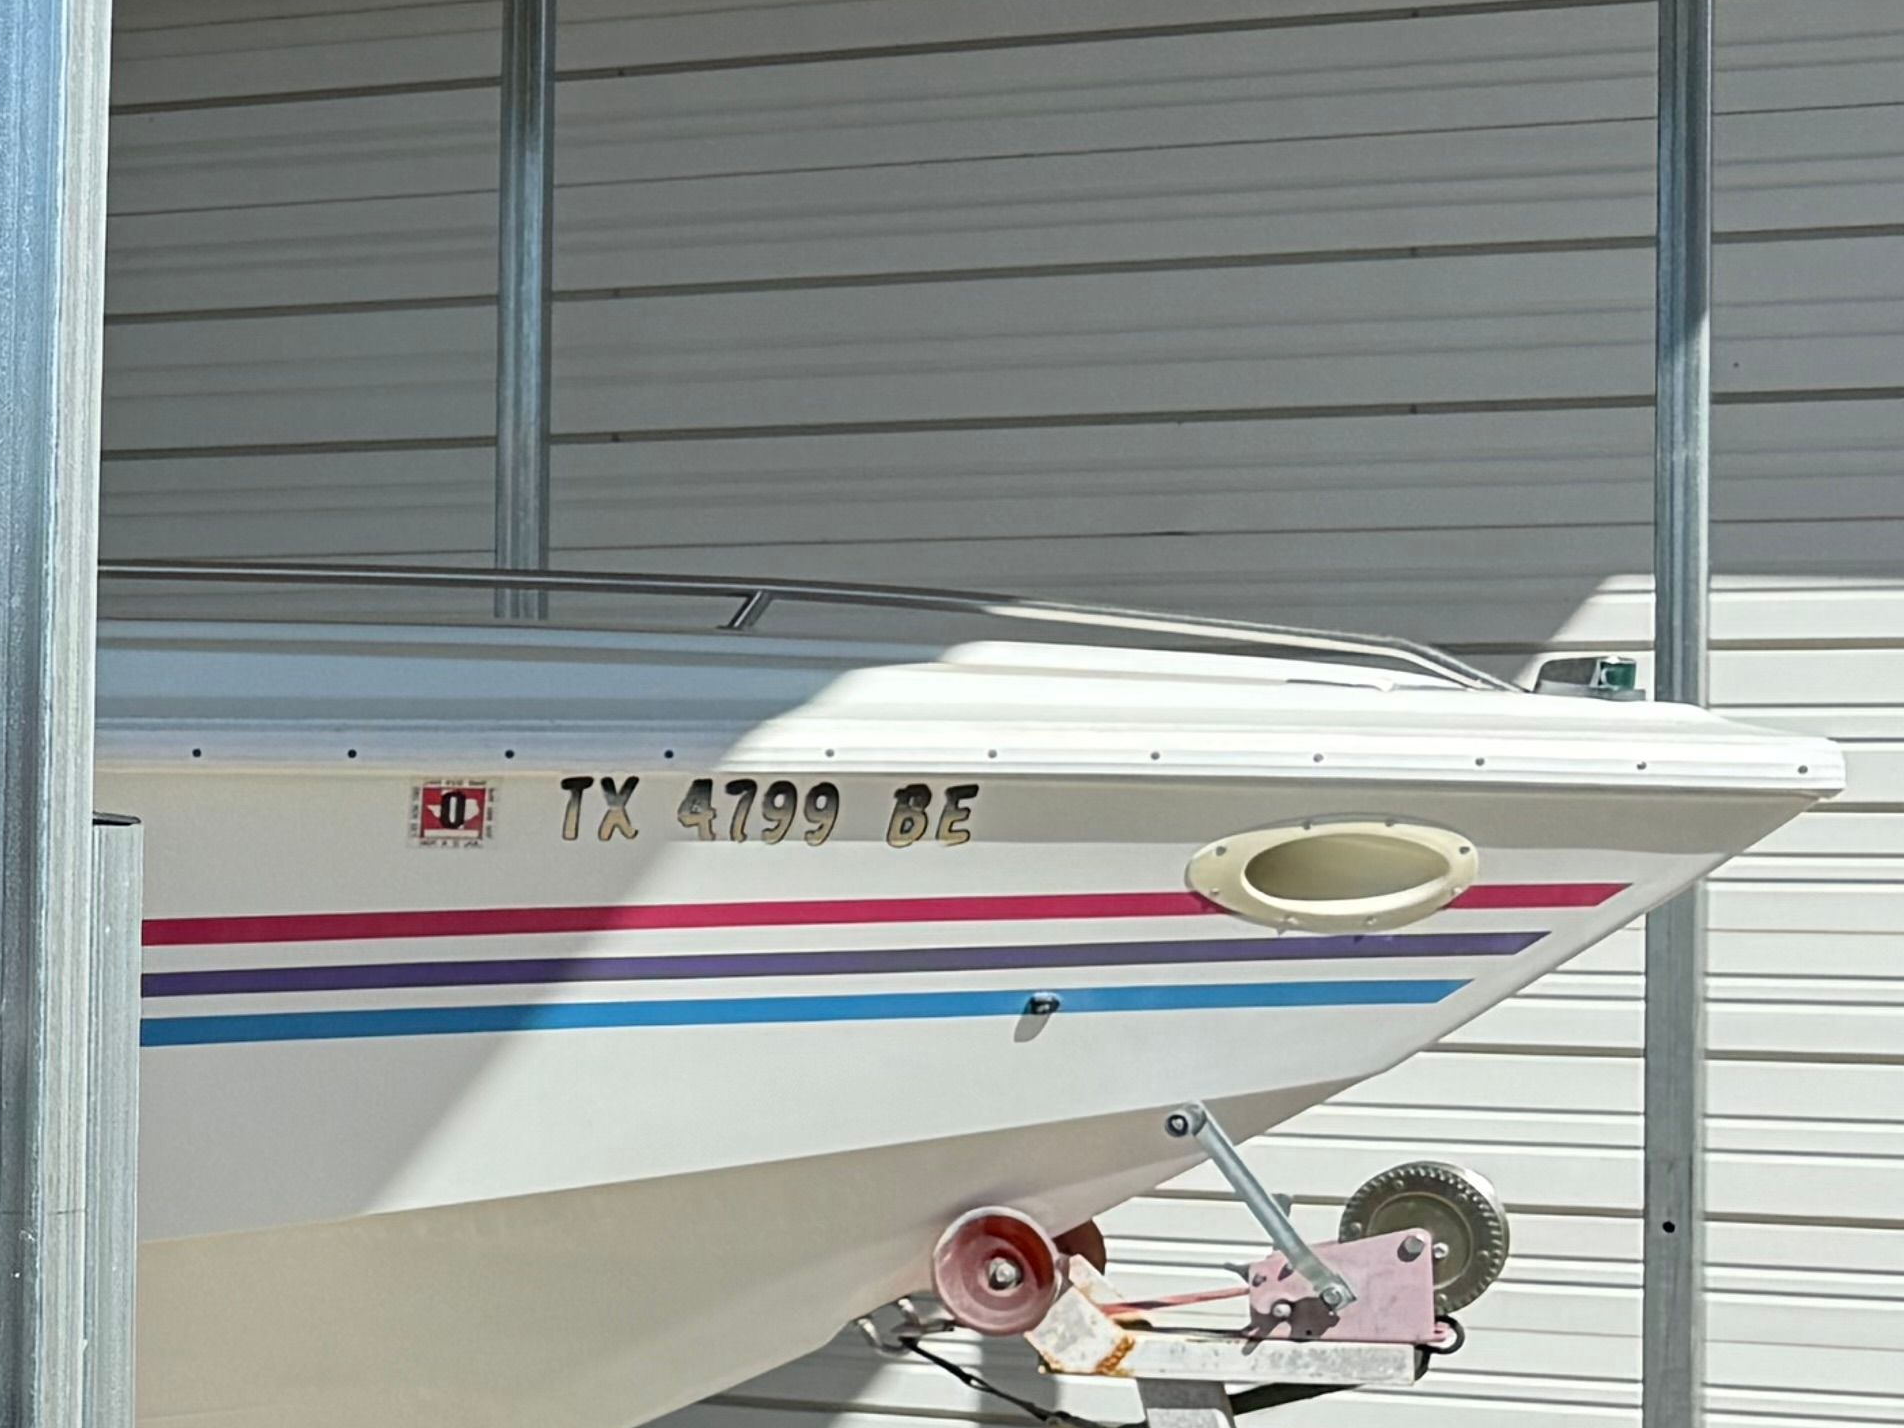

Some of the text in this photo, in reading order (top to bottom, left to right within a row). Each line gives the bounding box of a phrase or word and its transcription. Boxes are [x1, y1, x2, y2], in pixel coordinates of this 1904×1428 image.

[561, 776, 641, 842] TX
[676, 777, 842, 845] 4799
[886, 782, 982, 848] BE
